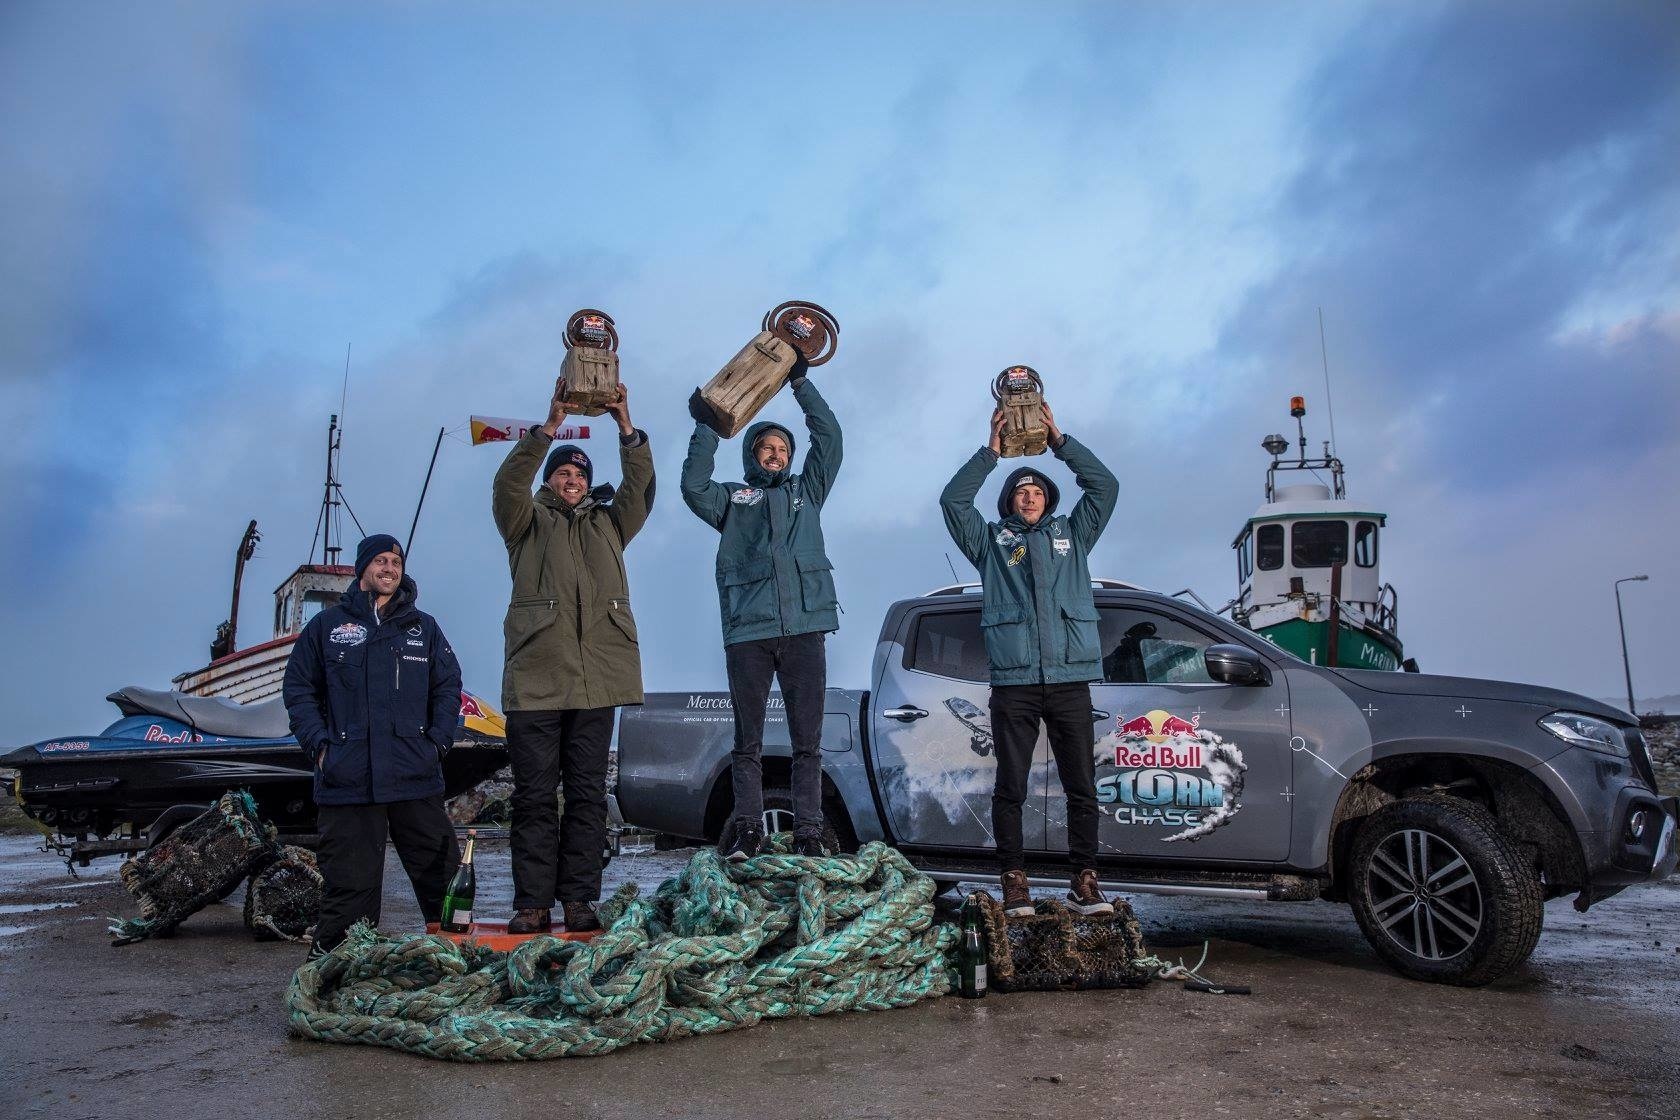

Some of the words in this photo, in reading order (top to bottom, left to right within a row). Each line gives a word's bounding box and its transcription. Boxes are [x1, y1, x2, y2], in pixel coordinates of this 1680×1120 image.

[1115, 746, 1157, 768] Red
[1160, 746, 1202, 768] Bull
[1095, 769, 1224, 808] STORM
[1114, 808, 1203, 827] CHASE
